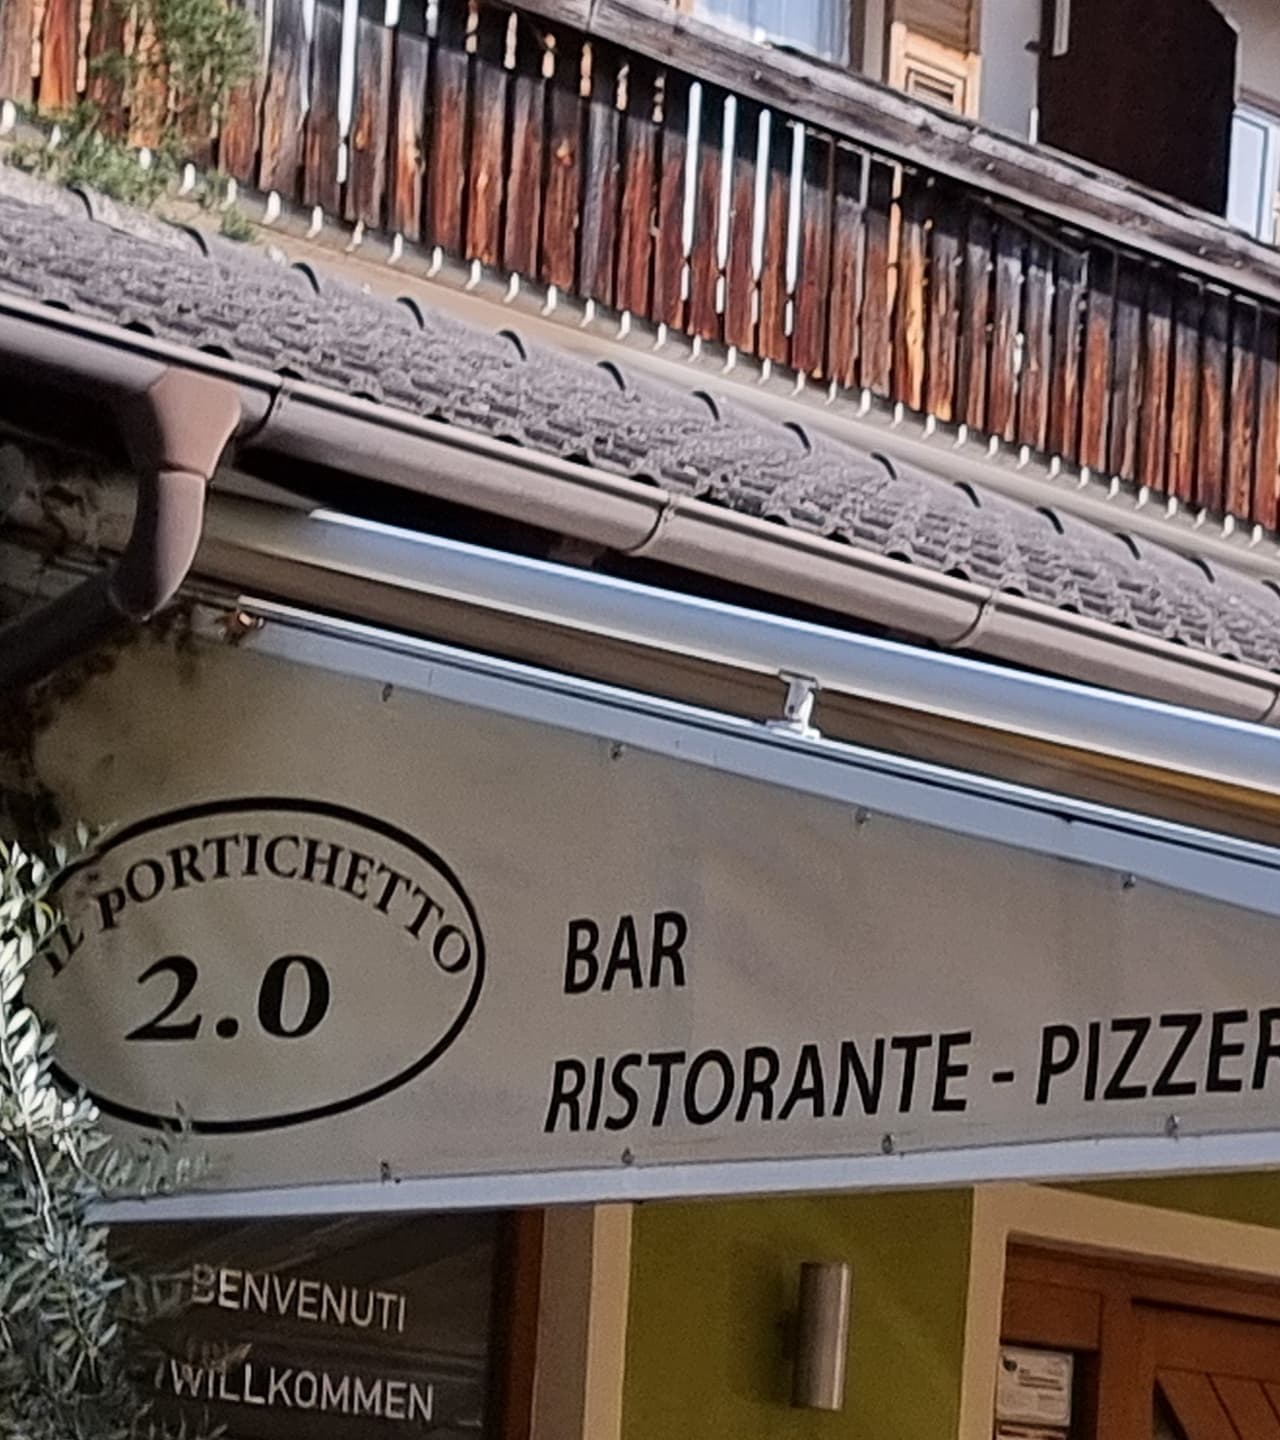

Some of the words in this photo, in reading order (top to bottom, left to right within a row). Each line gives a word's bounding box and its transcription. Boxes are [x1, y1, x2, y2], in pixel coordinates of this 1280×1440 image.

[98, 832, 471, 976] PORTICHETTO
[563, 911, 688, 995] BAR
[125, 954, 331, 1041] 2.0
[544, 1031, 972, 1134] RISTORANTE
[191, 1263, 406, 1332] BENVENUTI
[170, 1358, 434, 1422] WILLKOMMEN
